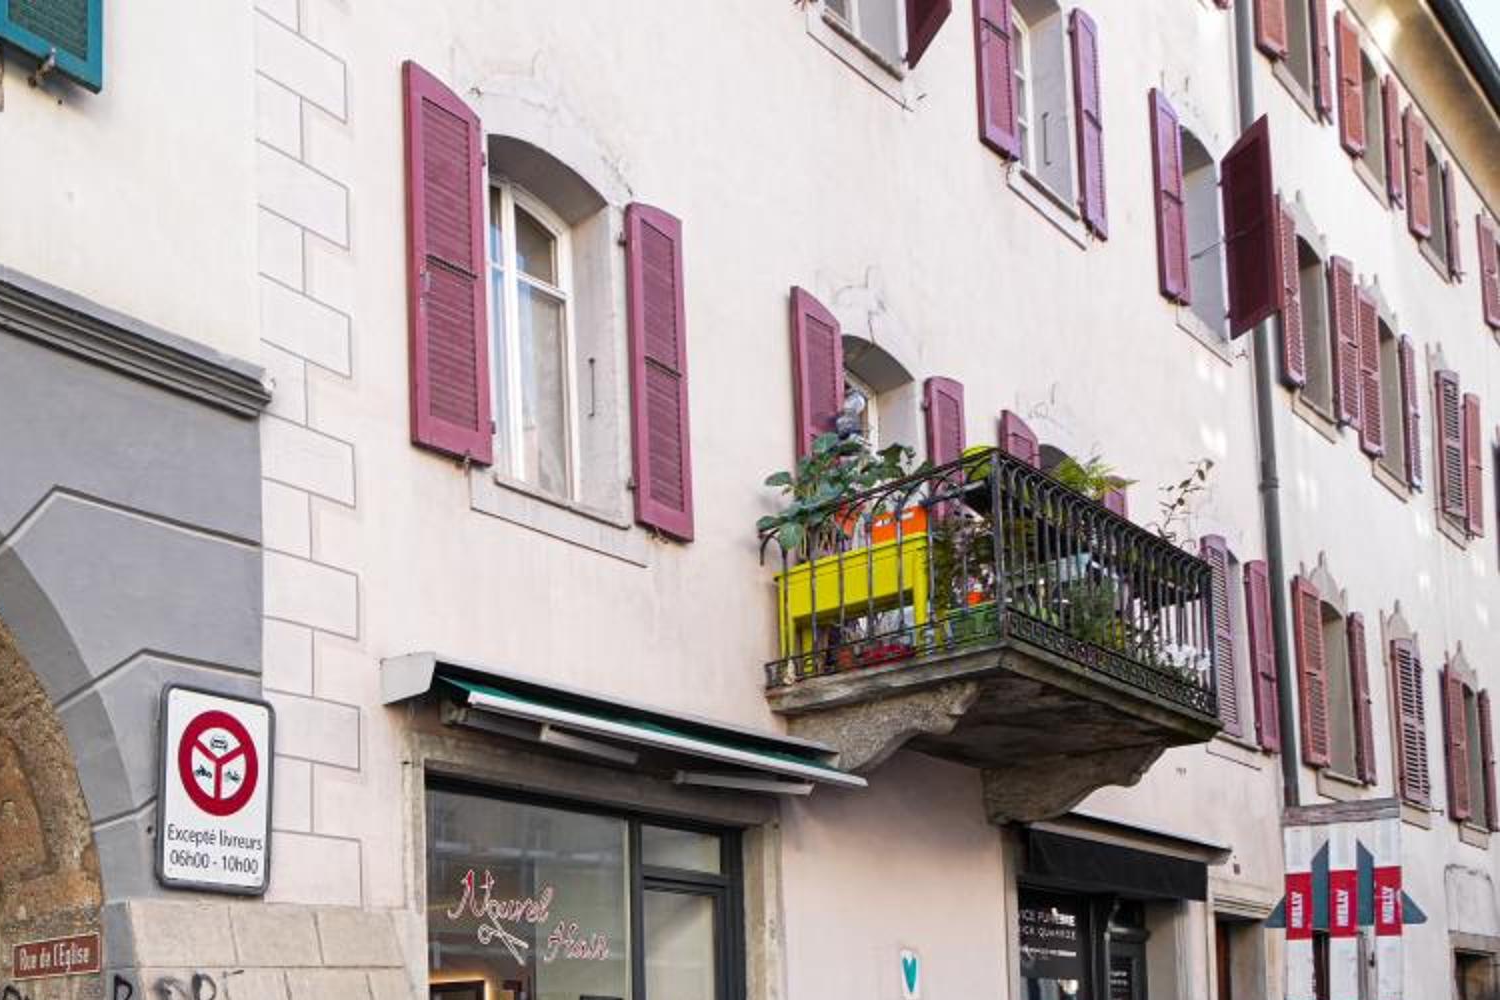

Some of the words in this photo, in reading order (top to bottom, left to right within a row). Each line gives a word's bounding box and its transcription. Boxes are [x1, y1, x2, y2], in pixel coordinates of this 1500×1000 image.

[167, 823, 217, 847] Excepté
[219, 829, 263, 851] livreurs
[169, 848, 210, 869] 06h00
[221, 854, 259, 875] 10h00
[19, 947, 37, 971] Rue
[40, 947, 51, 969] de
